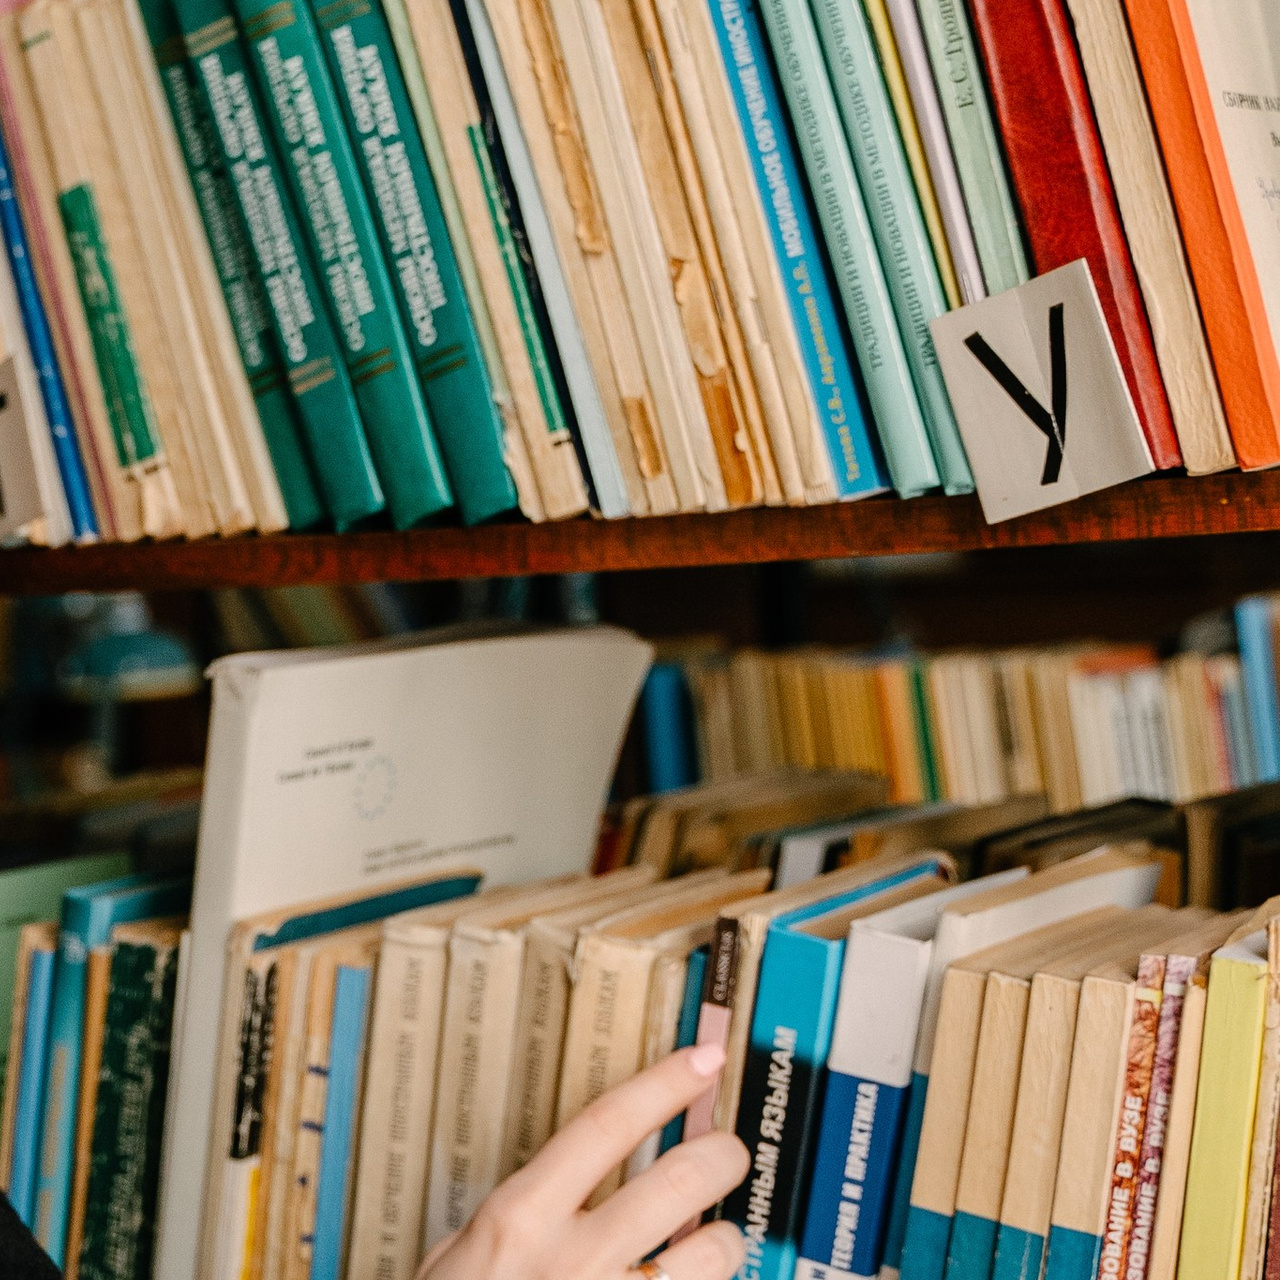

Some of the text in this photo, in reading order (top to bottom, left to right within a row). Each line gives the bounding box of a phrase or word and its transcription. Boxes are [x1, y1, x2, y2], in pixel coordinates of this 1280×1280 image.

[736, 64, 778, 154] ОБУЧЕНИЕ
[947, 61, 970, 85] С.
[952, 86, 975, 109] Е.
[1219, 90, 1263, 111] СБОРНИК
[792, 84, 829, 171] МЕТОДИКЕ
[845, 79, 883, 167] МЕТОДИКЕ
[224, 70, 315, 326] ИНОСТРАННЫМ ЯЗЫКАМ
[281, 54, 377, 316] ИНОСТРАННЫМ ЯЗЫКАМ
[356, 43, 447, 310] ИНОСТРАННЫМ ЯЗЫКАМ
[759, 150, 805, 258] МОБИЛЬНОЕ
[816, 170, 833, 186] В
[869, 166, 888, 182] В
[820, 185, 857, 271] НОВАЦИИ
[873, 181, 911, 266] НОВАЦИИ
[844, 270, 860, 284] И
[897, 265, 915, 281] И
[848, 283, 884, 371] ТРАДИЦИИ
[901, 280, 939, 367] ТРАДИЦИИ
[964, 301, 1065, 487] У
[757, 1025, 798, 1142] ЯЗЫКАМ
[1118, 1093, 1143, 1153] ВУЗЕ
[1148, 1089, 1170, 1148] ВУЗЕ
[830, 1081, 879, 1270] ТЕОРИЯ И ПРАКТИКА
[1115, 1160, 1134, 1179] В
[1144, 1156, 1160, 1173] В
